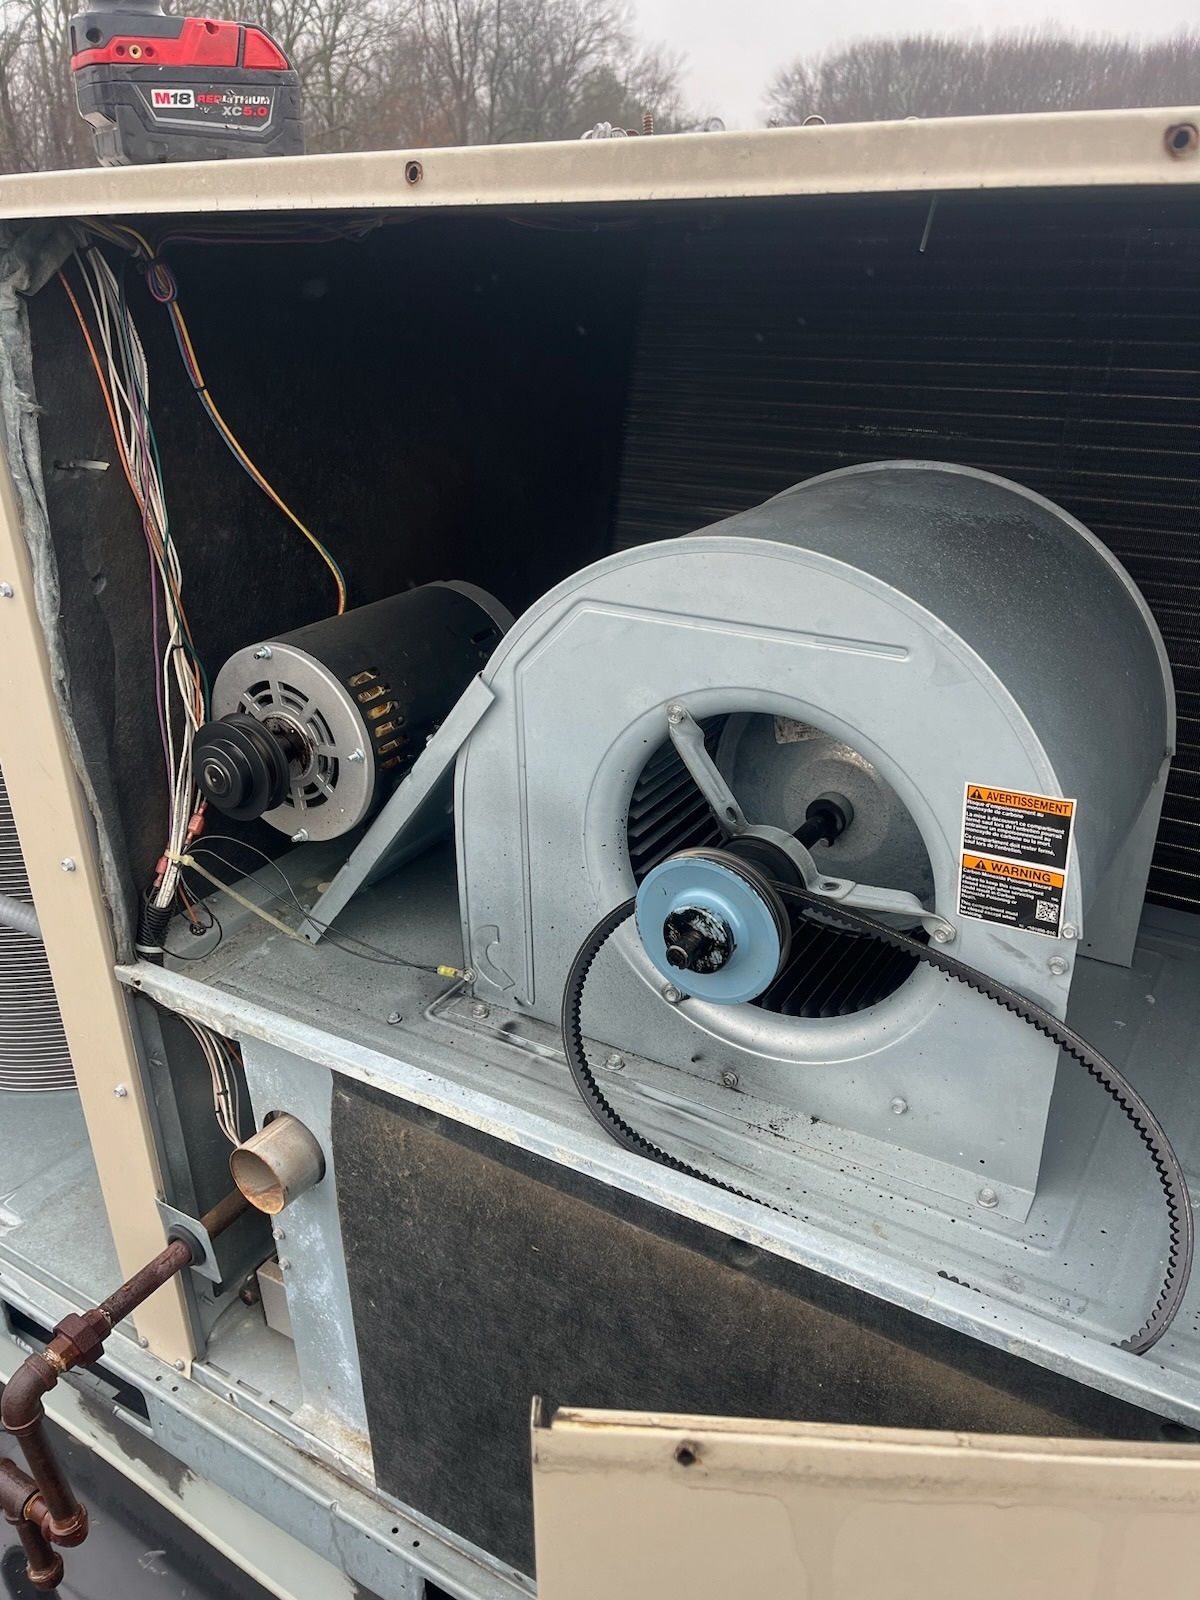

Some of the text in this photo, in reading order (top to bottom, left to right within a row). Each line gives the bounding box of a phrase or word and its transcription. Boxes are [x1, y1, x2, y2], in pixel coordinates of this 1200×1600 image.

[154, 92, 191, 104] M18
[987, 792, 1069, 814] AVERTISSEMENT
[991, 862, 1051, 882] WARNING
